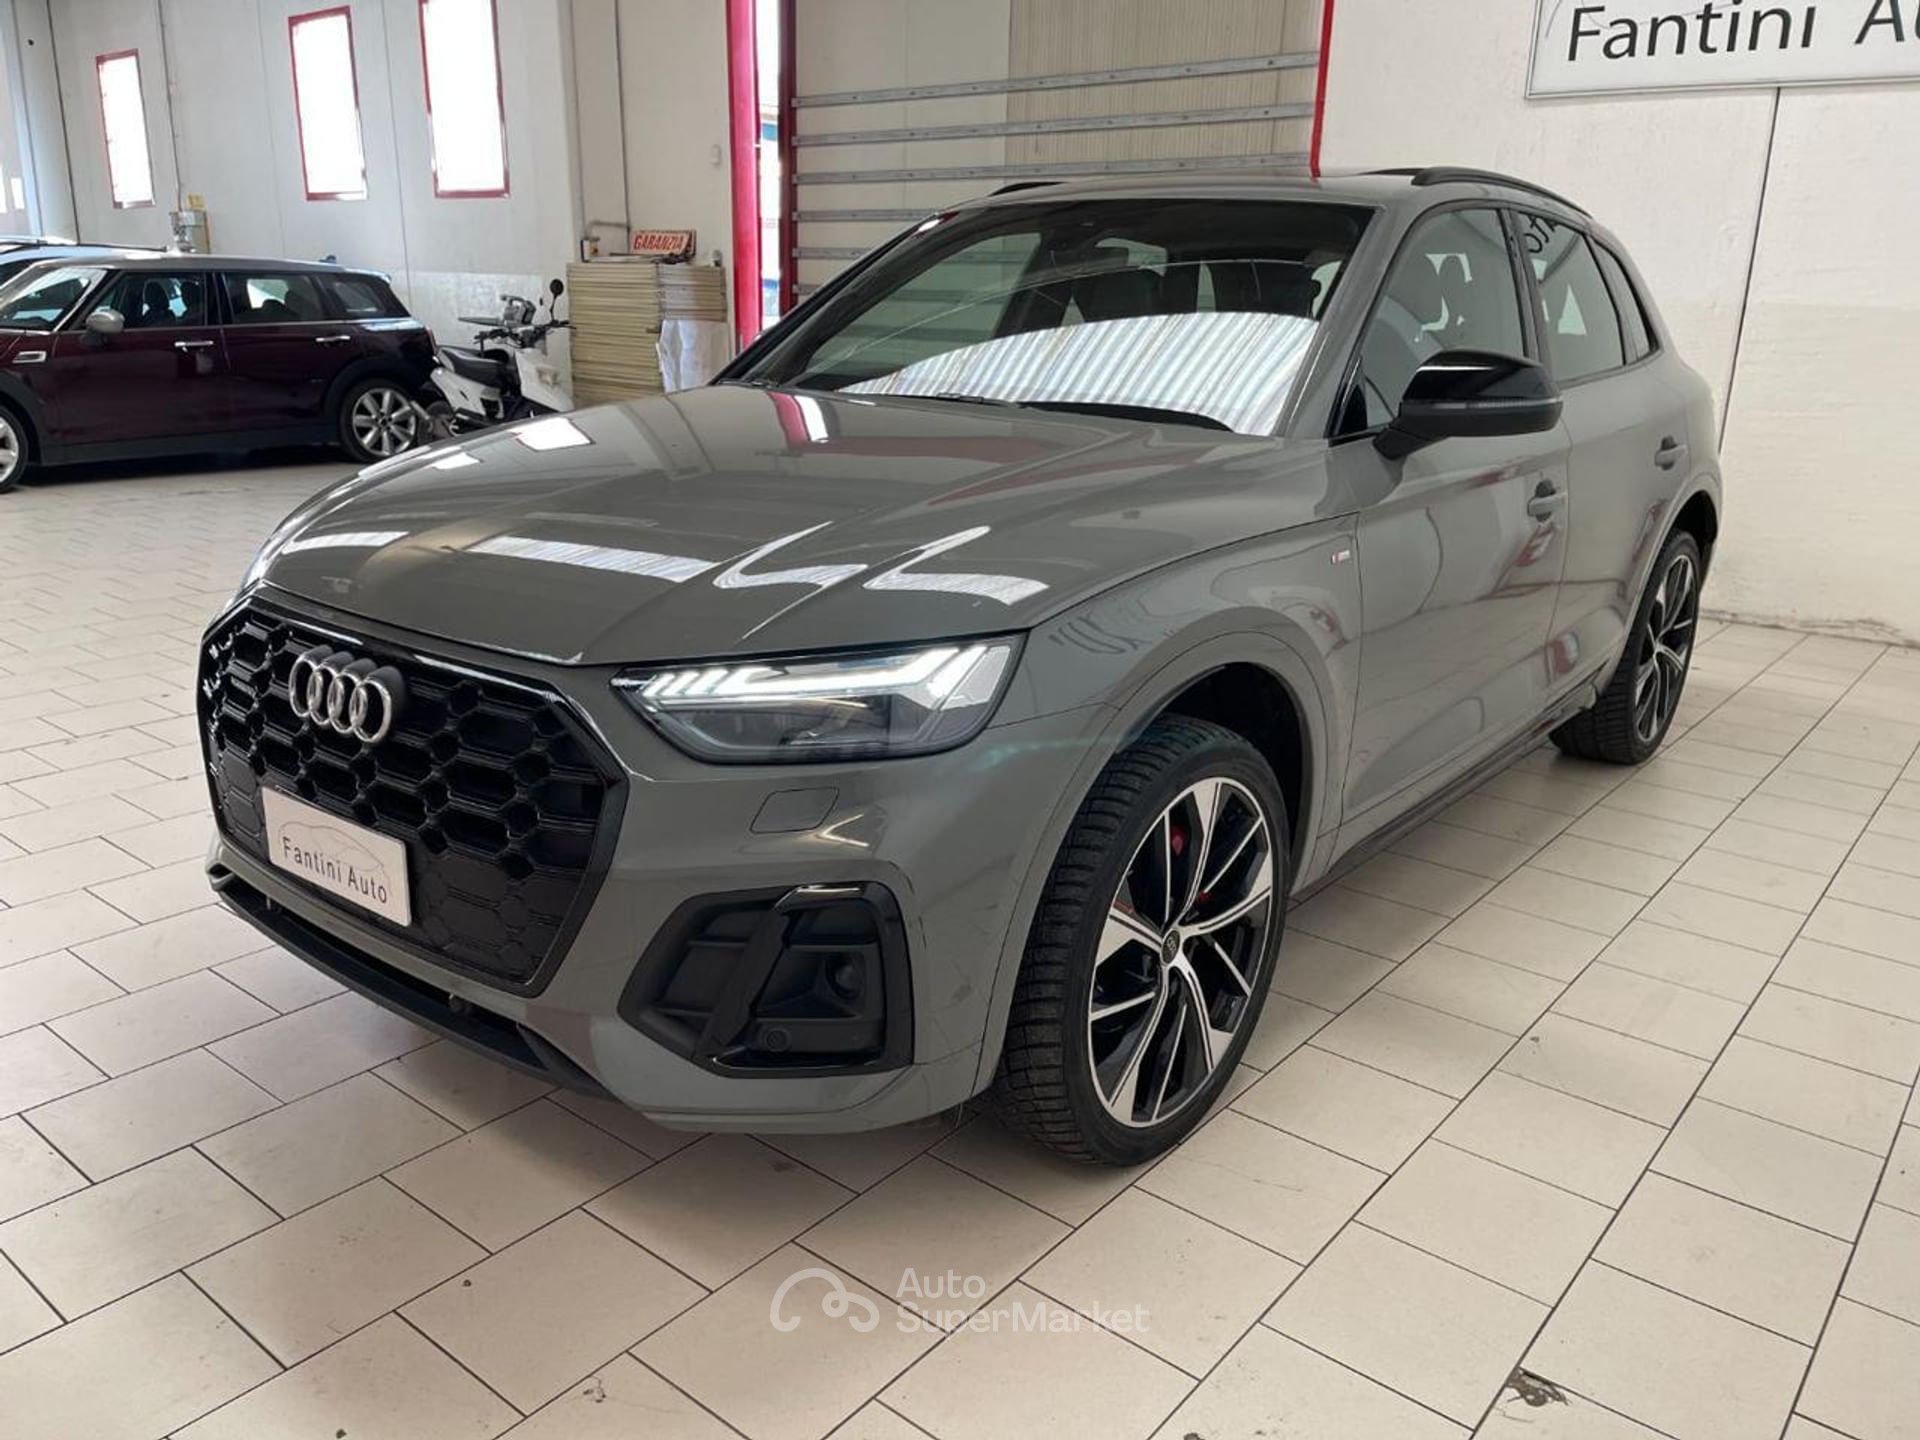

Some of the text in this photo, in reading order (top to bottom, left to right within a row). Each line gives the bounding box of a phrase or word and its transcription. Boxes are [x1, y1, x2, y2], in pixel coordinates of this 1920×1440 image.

[1567, 0, 1920, 62] Fantini A
[282, 836, 388, 904] Fantini Auto
